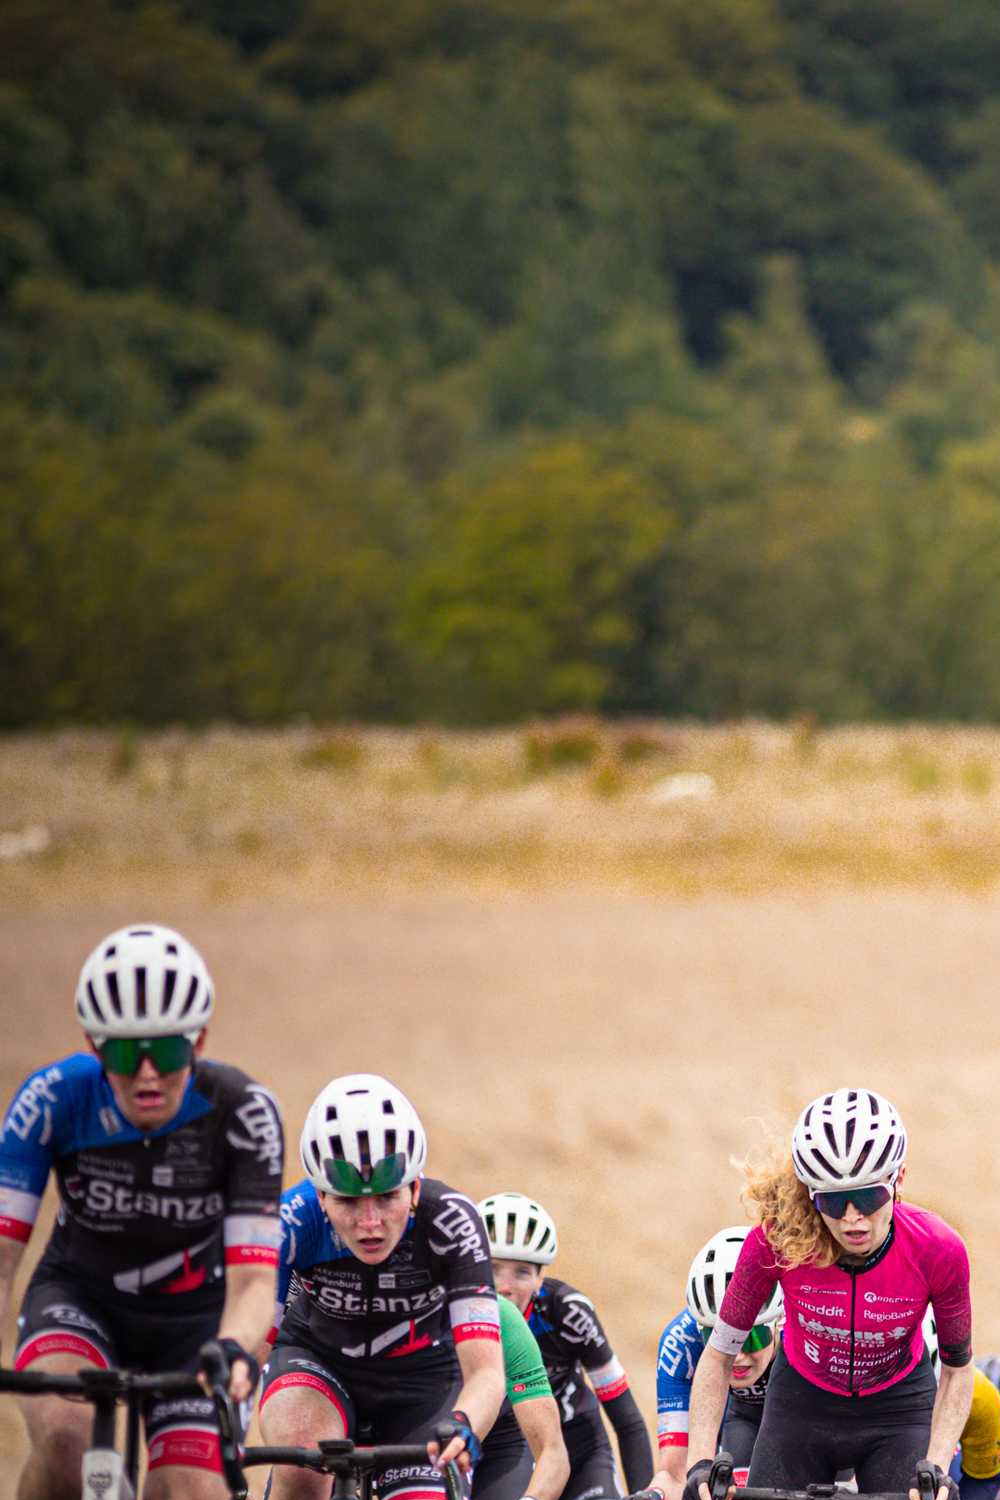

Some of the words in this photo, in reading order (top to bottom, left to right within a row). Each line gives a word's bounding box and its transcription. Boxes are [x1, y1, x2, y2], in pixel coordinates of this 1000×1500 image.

[86, 1179, 224, 1221] Stanza
[318, 1285, 447, 1313] Stanza
[863, 1309, 914, 1323] RegioBank
